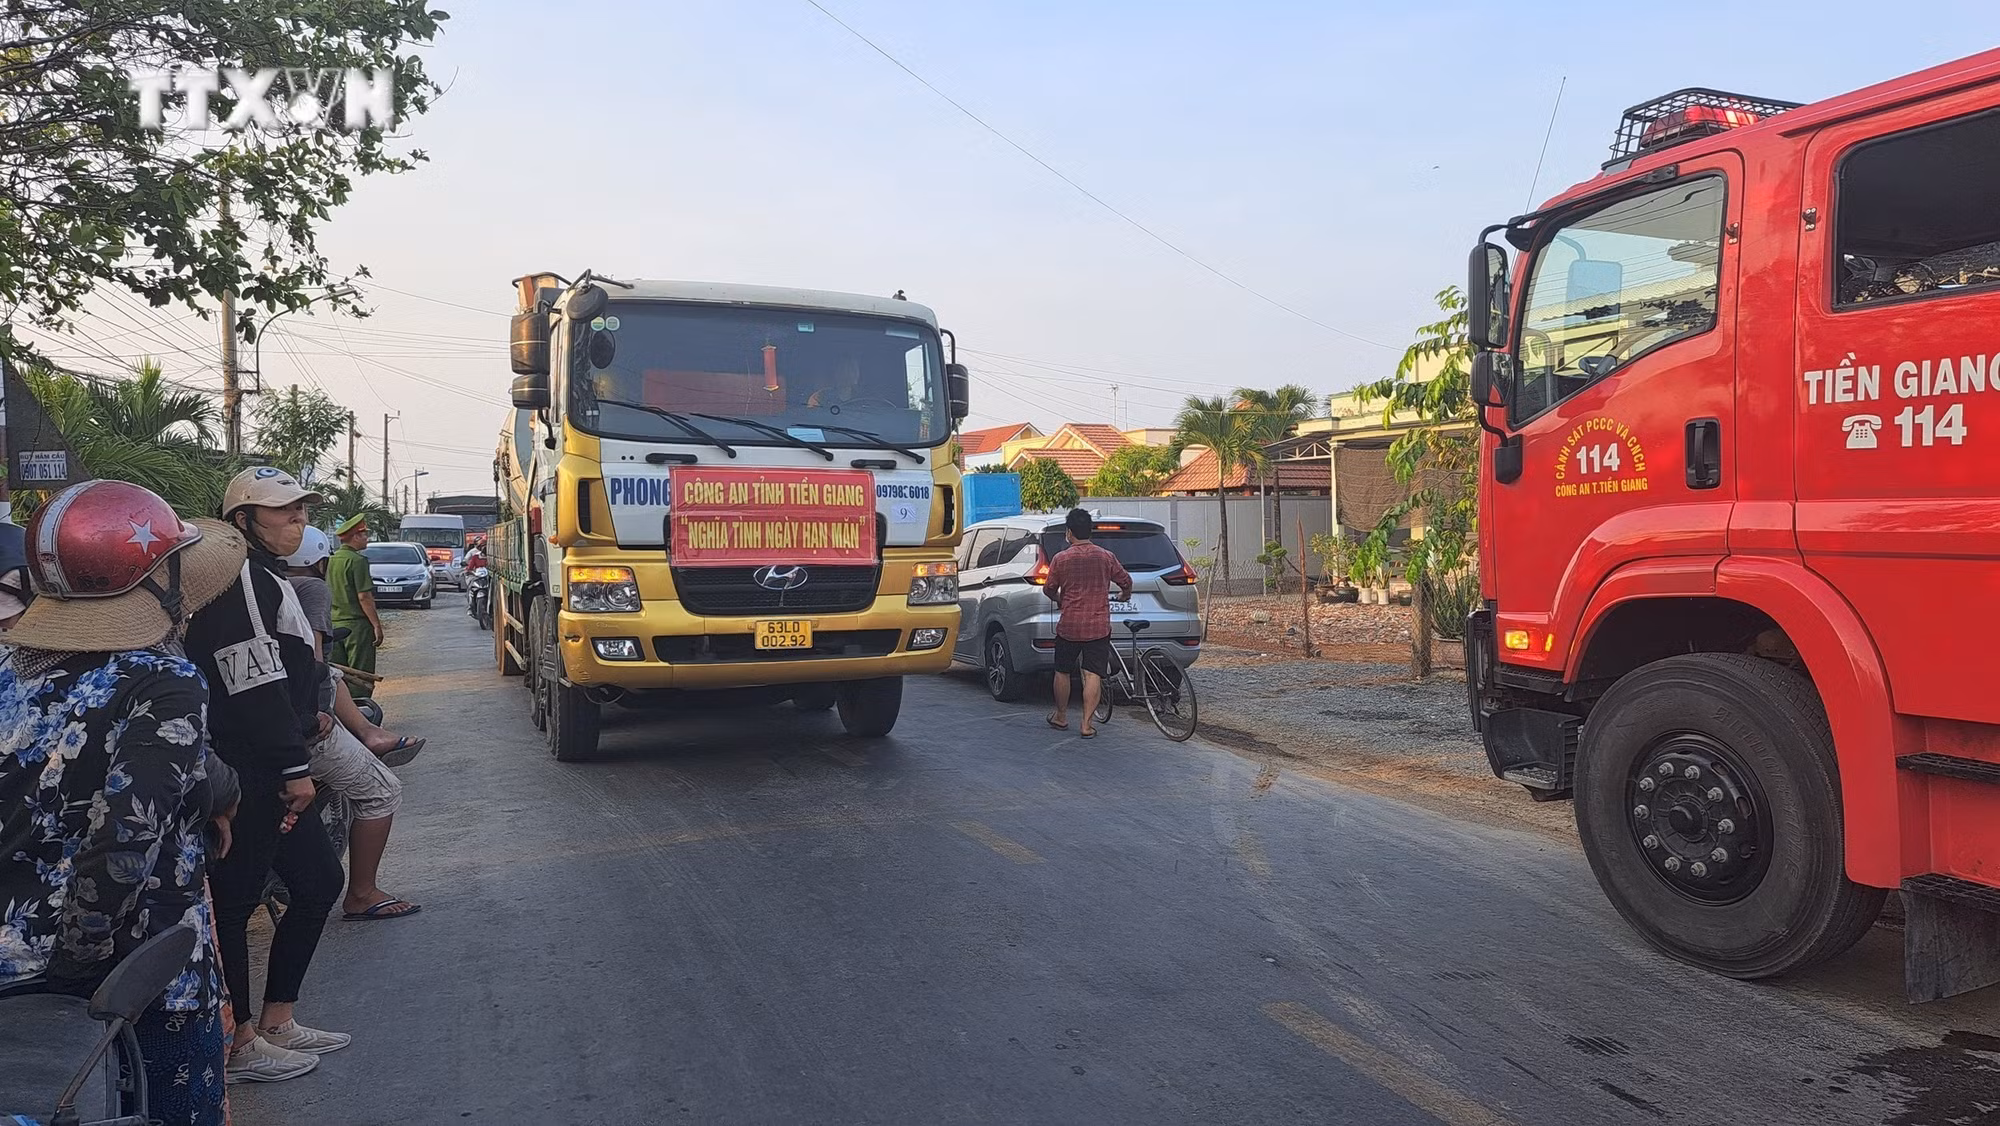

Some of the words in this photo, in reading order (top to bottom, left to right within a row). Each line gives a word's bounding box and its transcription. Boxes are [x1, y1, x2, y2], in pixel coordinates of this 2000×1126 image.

[1804, 352, 1880, 405] TIỀN
[1894, 403, 1967, 447] 114
[1567, 425, 1584, 446] SÁT
[1586, 417, 1614, 432] PCCC
[1616, 422, 1630, 440] VÀ
[1627, 436, 1646, 472] CNCH
[1576, 443, 1620, 474] 114
[684, 478, 725, 505] CÔNG
[729, 482, 748, 504] AN
[752, 476, 784, 505] TỈNH
[788, 477, 819, 505] TIỀN
[823, 483, 864, 506] GIANG
[1556, 482, 1576, 497] CÔNG
[1580, 483, 1590, 495] AN
[1621, 477, 1648, 492] GIANG
[900, 507, 908, 520] 9
[732, 516, 761, 549] TÌNH
[766, 516, 799, 549] NGÀY
[802, 522, 828, 554] HẠN
[762, 635, 806, 647] 002.92
[768, 621, 800, 633] 63LD
